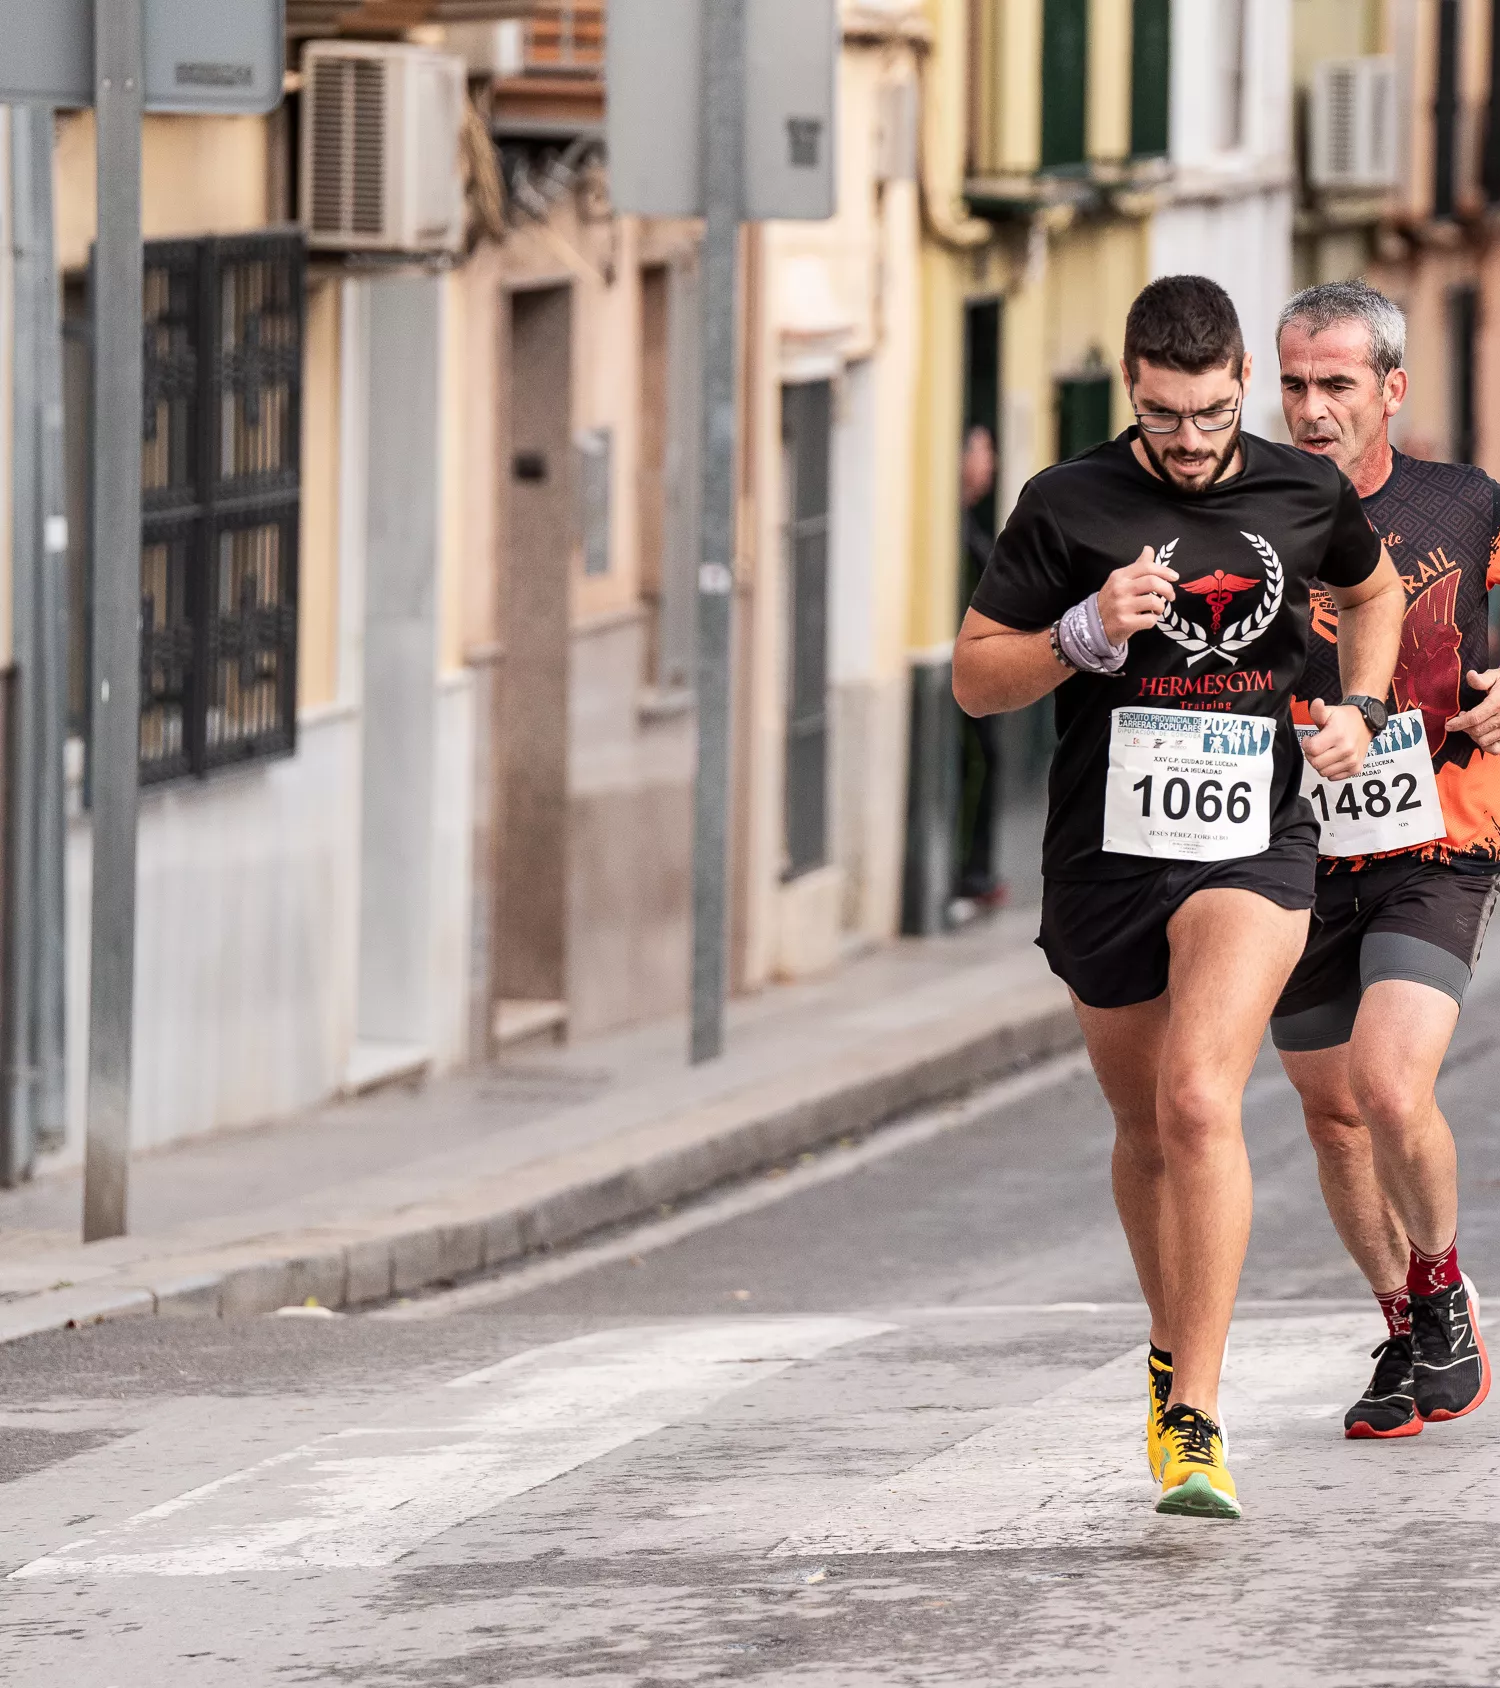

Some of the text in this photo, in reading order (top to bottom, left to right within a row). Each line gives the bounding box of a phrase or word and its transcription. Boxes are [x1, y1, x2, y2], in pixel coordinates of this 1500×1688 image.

[1400, 547, 1457, 595] RAIL
[1179, 700, 1232, 711] Training
[1119, 712, 1149, 721] CIRCUITO
[1150, 714, 1191, 725] PROVINCIAL
[1118, 719, 1202, 733] CARRERAS POPULARES
[1203, 717, 1243, 735] 2024
[1181, 758, 1205, 766] CIUDAD
[1190, 767, 1223, 775] IGUALDAD
[1132, 774, 1252, 824] 1066
[1310, 772, 1422, 822] 1482
